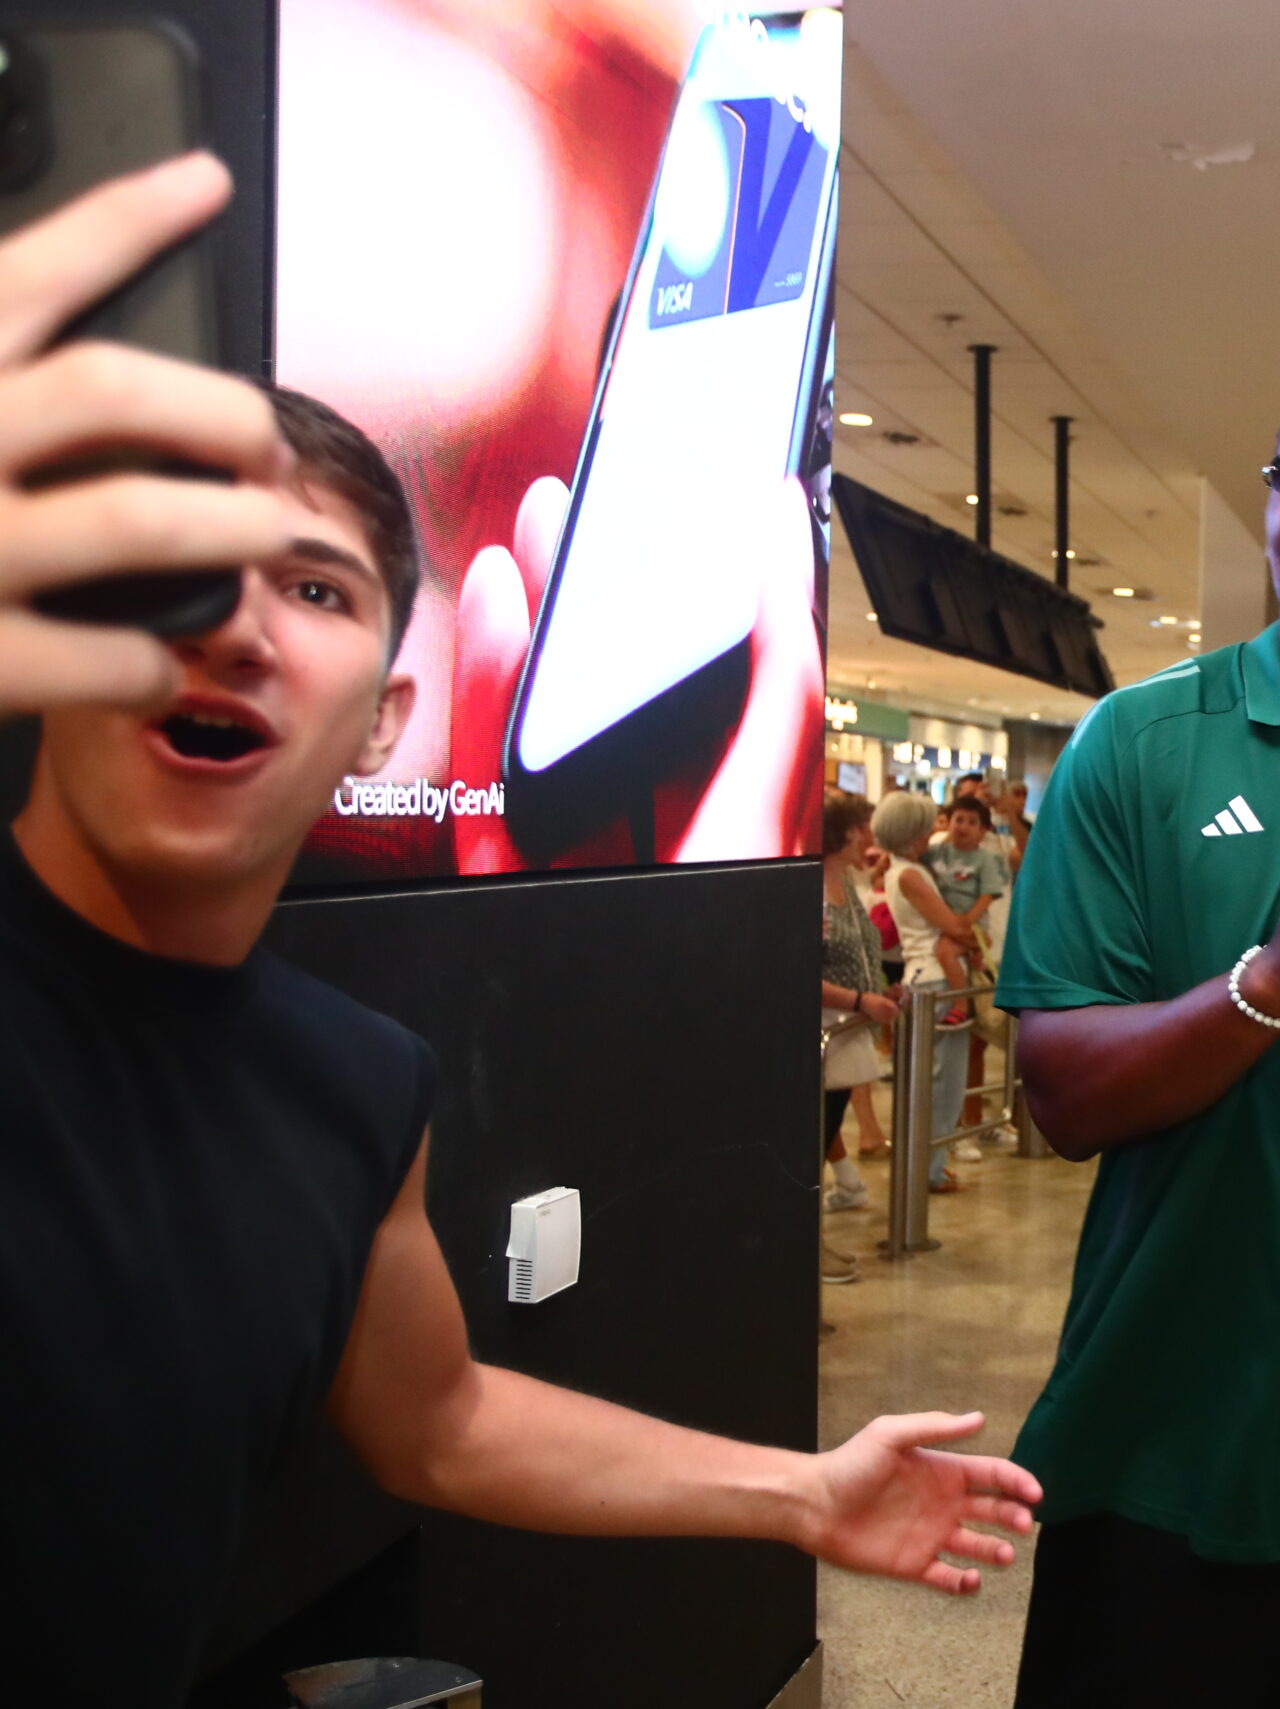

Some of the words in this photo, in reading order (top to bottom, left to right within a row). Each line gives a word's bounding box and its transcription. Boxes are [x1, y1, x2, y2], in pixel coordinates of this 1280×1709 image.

[656, 281, 694, 317] VISA
[334, 776, 421, 816] Created
[422, 778, 449, 824] by
